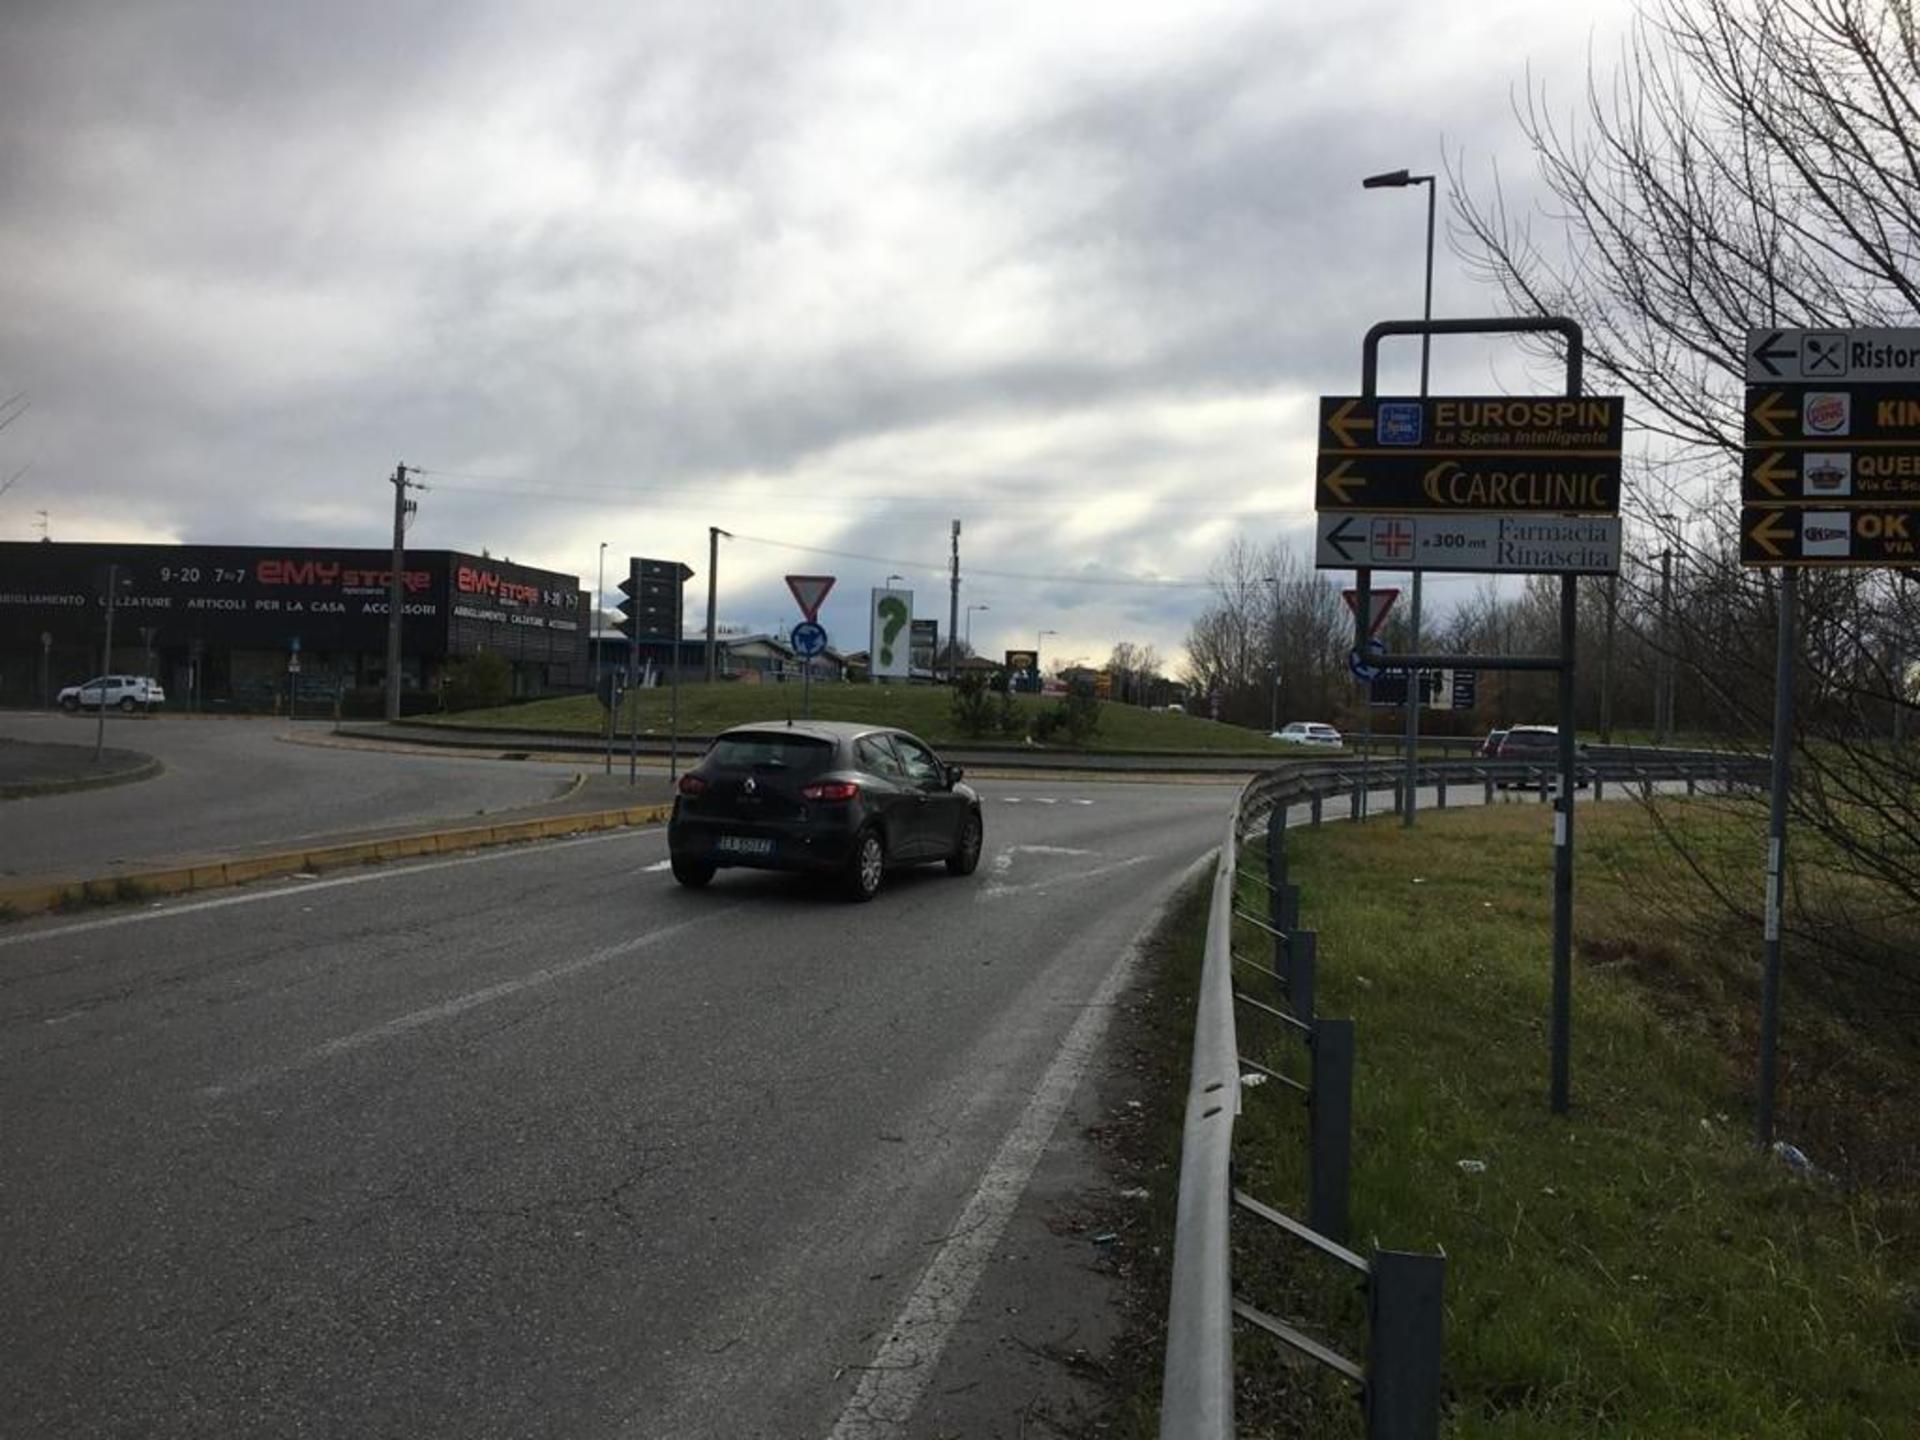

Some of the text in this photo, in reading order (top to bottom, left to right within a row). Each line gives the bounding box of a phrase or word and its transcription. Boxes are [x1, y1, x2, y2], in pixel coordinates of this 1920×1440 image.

[1435, 402, 1610, 427] EUROSPIN
[1435, 429, 1608, 446] La Spesa Intelligente
[1450, 472, 1608, 505] CARCLINIC
[1499, 518, 1607, 542] Farmacia
[1857, 514, 1909, 538] OK
[1434, 533, 1466, 549] 300
[1883, 541, 1914, 553] VIA
[1496, 542, 1609, 568] Rinascita
[160, 567, 200, 582] 9-20
[187, 598, 246, 610] ARTICOLI
[255, 600, 280, 611] PER
[286, 601, 303, 612] LA
[311, 602, 345, 613] CASA
